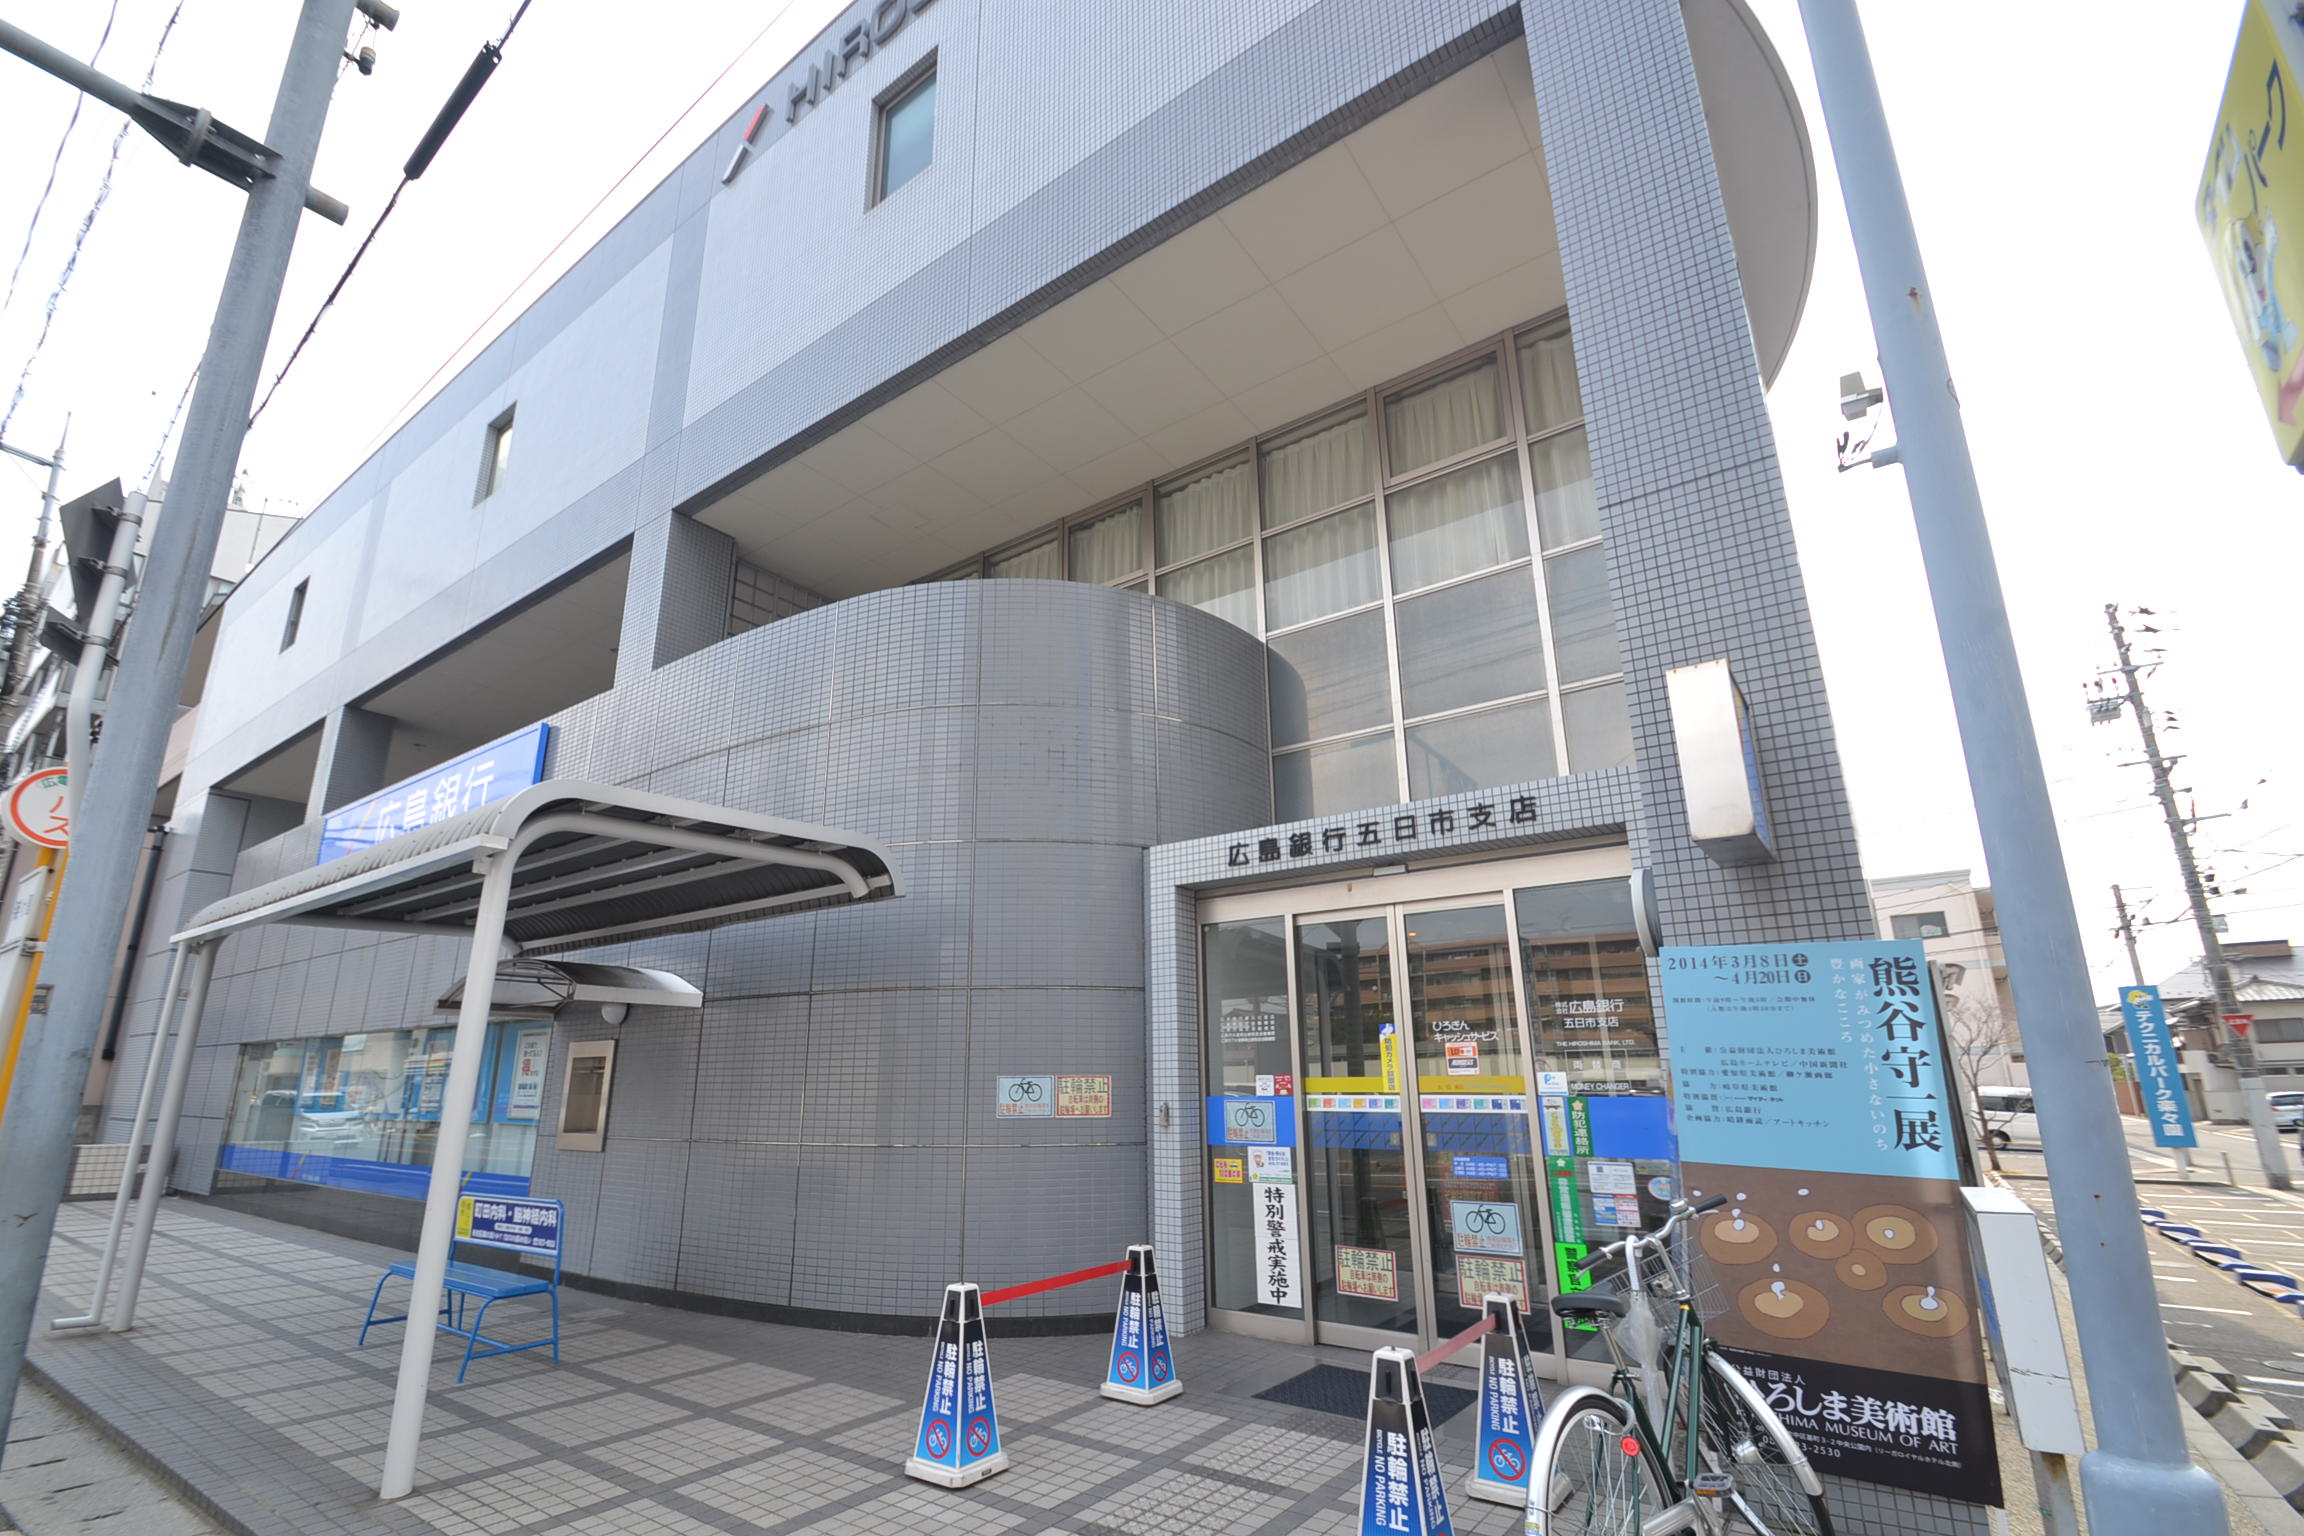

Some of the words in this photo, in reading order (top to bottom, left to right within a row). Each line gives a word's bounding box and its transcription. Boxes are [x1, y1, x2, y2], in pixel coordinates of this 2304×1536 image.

[786, 0, 932, 123] HIRO
[374, 759, 496, 845] 広島銀行
[1227, 795, 1539, 867] 広島銀行五日市支店
[1432, 1020, 1471, 1031] ひろぎん
[1563, 1016, 1620, 1029] 五日市支店
[1569, 999, 1624, 1014] 広島銀行
[1433, 1030, 1500, 1042] キャッシュサービス
[1868, 956, 1944, 1152] 熊谷守一展
[1057, 1078, 1108, 1094] 駐輪禁止
[1570, 1082, 1595, 1091] MONEY
[1595, 1081, 1631, 1090] CHANGER
[2135, 1009, 2185, 1137] テクニカルパーク楽々園
[1571, 1110, 1589, 1155] 防犯連絡所
[1264, 1187, 1290, 1304] 特別警戒実施中
[1337, 1248, 1393, 1272] 駐輪禁止
[1458, 1257, 1523, 1283] 駐輪禁止
[1127, 1291, 1142, 1350] 駐輪禁止
[937, 1357, 944, 1370] NO
[939, 1342, 957, 1416] 駐輪禁止
[966, 1360, 973, 1374] NO
[971, 1340, 987, 1413] 駐輪禁止
[1489, 1375, 1497, 1389] NO
[932, 1371, 942, 1412] PARKING
[967, 1374, 975, 1414] PARKING
[1490, 1392, 1500, 1431] PARKING
[1498, 1357, 1520, 1435] 駐輪禁止
[1825, 1422, 1893, 1444] MUSEUM
[1899, 1433, 1922, 1449] OF
[1928, 1440, 1959, 1456] ART
[1376, 1454, 1386, 1474] NO
[1387, 1432, 1410, 1533] 駐輪禁止
[1418, 1427, 1444, 1525] 駐輪禁止
[1375, 1477, 1387, 1526] PARKING
[1419, 1458, 1427, 1474] NO
[1423, 1478, 1436, 1531] PARKING
